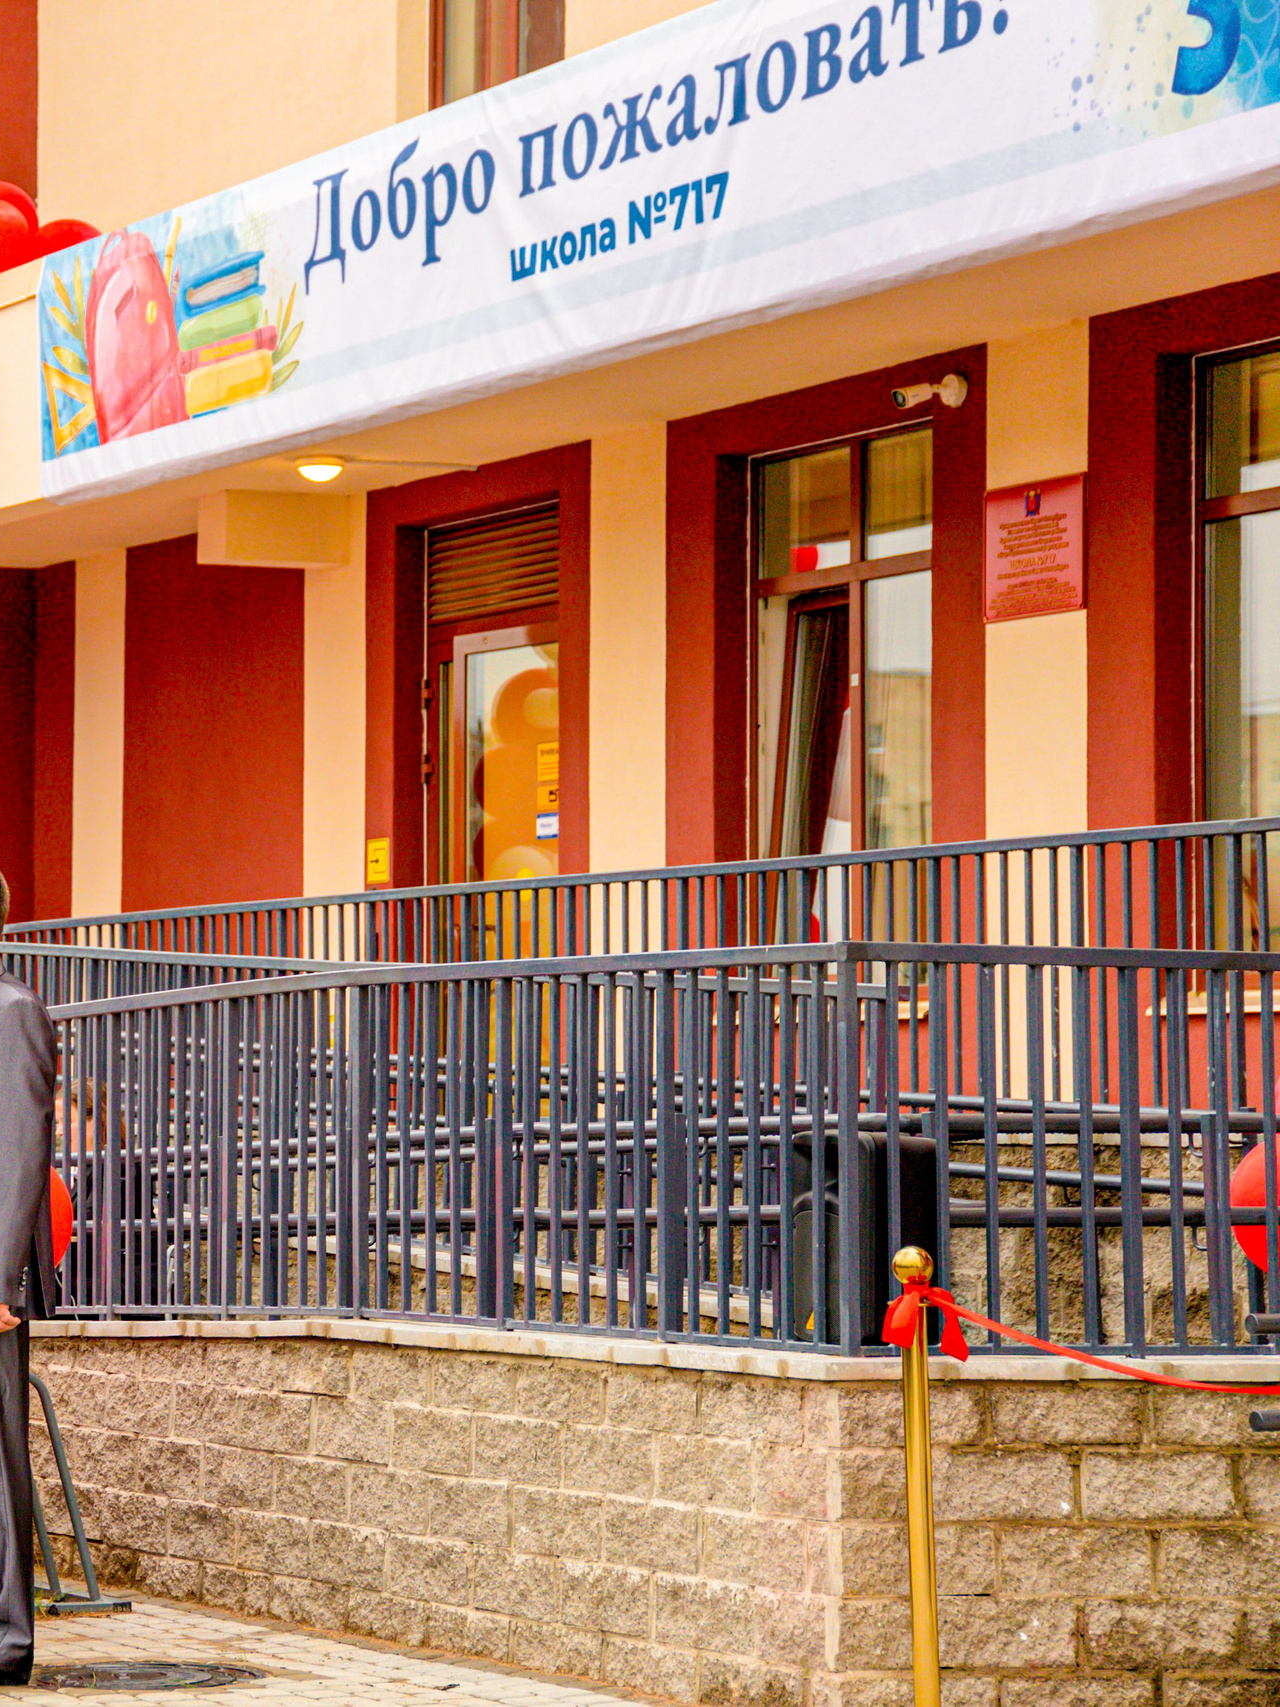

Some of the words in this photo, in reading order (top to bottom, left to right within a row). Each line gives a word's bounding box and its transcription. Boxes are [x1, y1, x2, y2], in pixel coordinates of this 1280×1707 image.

[303, 136, 496, 296] Добро
[510, 217, 616, 282] школа
[628, 171, 730, 247] №717
